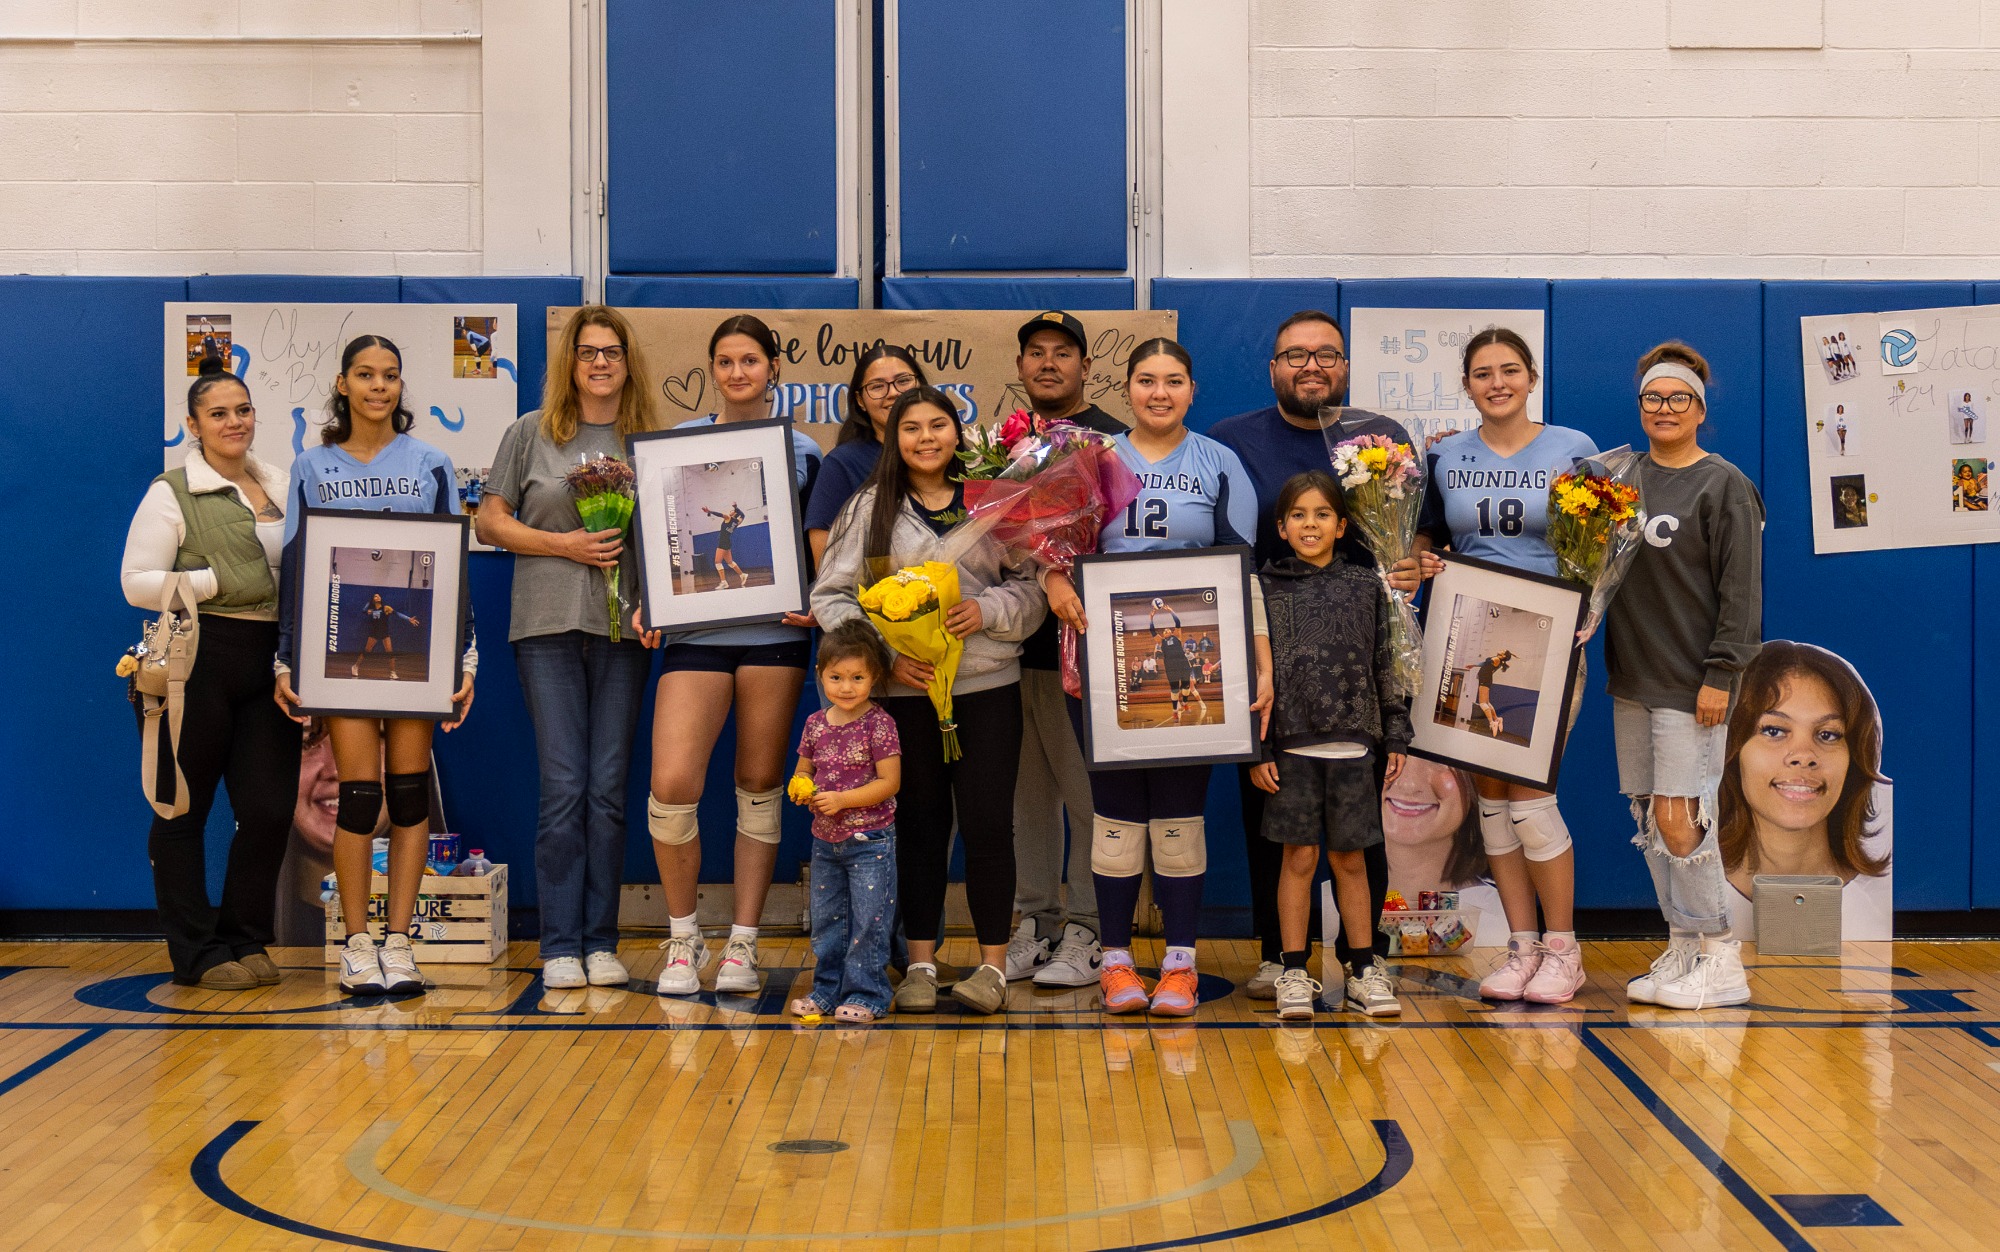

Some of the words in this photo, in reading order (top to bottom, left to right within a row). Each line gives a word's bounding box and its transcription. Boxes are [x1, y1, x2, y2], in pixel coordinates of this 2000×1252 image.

[906, 338, 973, 371] our
[1380, 329, 1429, 363] #5
[259, 370, 280, 391] #12
[1888, 384, 1935, 417] #24
[318, 476, 422, 504] ONONDAGA
[1134, 472, 1203, 495] NDAGA
[1446, 467, 1559, 490] ONONDAG
[666, 494, 678, 535] BECKERING
[1123, 496, 1169, 539] 12
[1475, 496, 1526, 538] 18
[329, 604, 340, 634] LATOYA
[1113, 610, 1126, 657] BUCKTOOTH
[328, 634, 338, 652] #24
[1116, 657, 1128, 693] CHYLURE
[1119, 694, 1129, 712] #12
[367, 900, 453, 917] CHURE
[378, 924, 424, 940] #2
